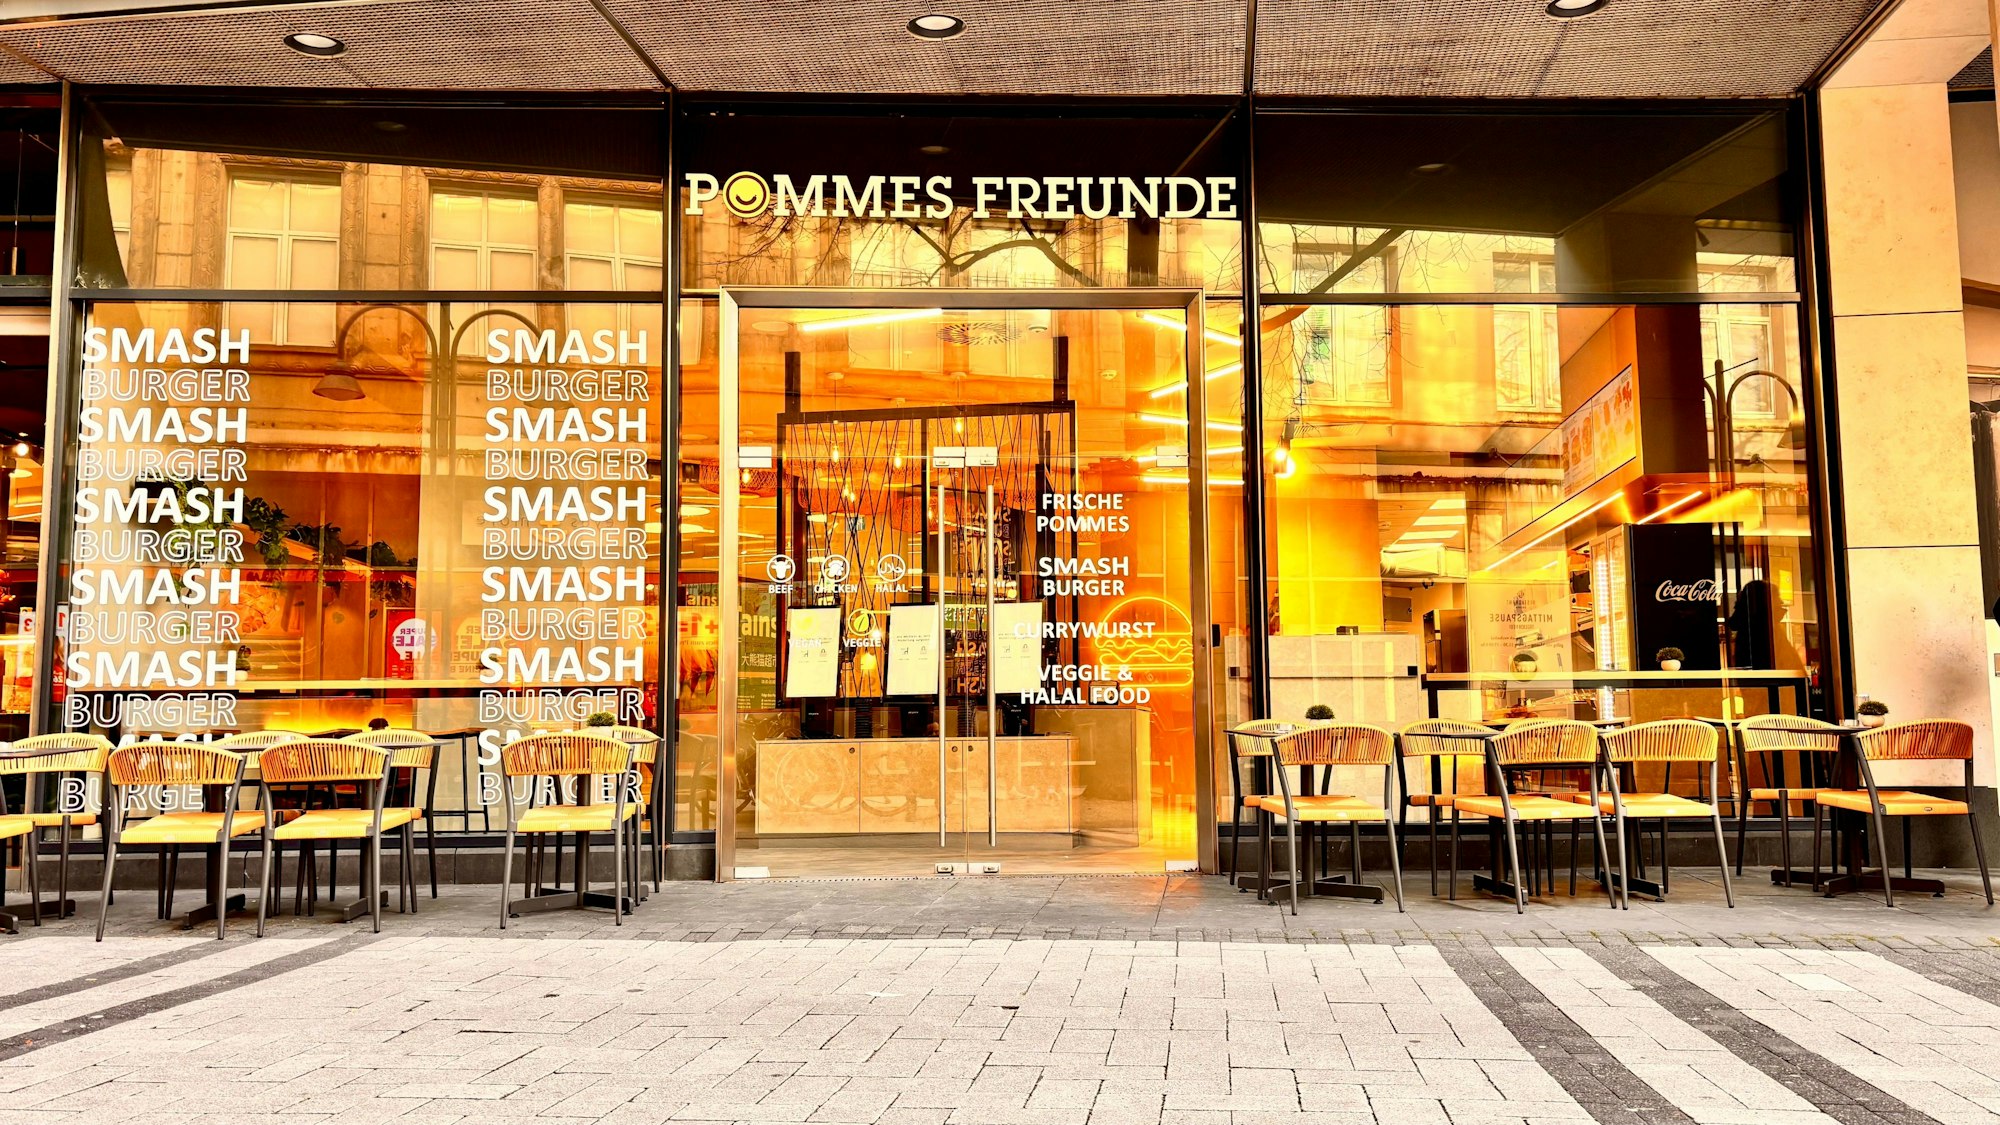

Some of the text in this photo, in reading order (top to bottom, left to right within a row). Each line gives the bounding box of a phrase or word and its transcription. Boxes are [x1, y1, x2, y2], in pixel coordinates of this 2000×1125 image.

[684, 171, 1238, 220] POMMES FREUNDE
[82, 327, 250, 364] SMASH
[486, 329, 647, 364] SMASH
[82, 368, 251, 402] BURGER
[486, 369, 649, 402] BURGER
[78, 407, 247, 444] SMASH
[485, 407, 647, 443] SMASH
[76, 448, 248, 482] BURGER
[484, 448, 649, 481] BURGER
[74, 487, 244, 524] SMASH
[483, 486, 646, 522] SMASH
[1042, 493, 1123, 510] FRISCHE
[1036, 515, 1130, 533] POMMES
[72, 529, 244, 563] BURGER
[483, 528, 648, 560] BURGER
[1039, 556, 1129, 578] SMASH
[70, 569, 241, 606] SMASH
[481, 566, 645, 603] SMASH
[768, 585, 794, 594] BEEF
[875, 584, 909, 593] HALAL
[1043, 579, 1125, 596] BURGER
[1655, 578, 1725, 602] Coca-Cola
[68, 610, 241, 645] BURGER
[481, 608, 646, 641] BURGER
[1013, 622, 1156, 639] CURRYWURST
[788, 639, 823, 648] VEGAN
[842, 637, 882, 647] VEGGIE
[65, 650, 237, 688] SMASH
[479, 647, 643, 684] SMASH
[1037, 664, 1133, 682] VEGGIE &
[63, 692, 237, 728] BURGER
[478, 689, 646, 723] BURGER
[1020, 687, 1151, 705] HALAL FOOD
